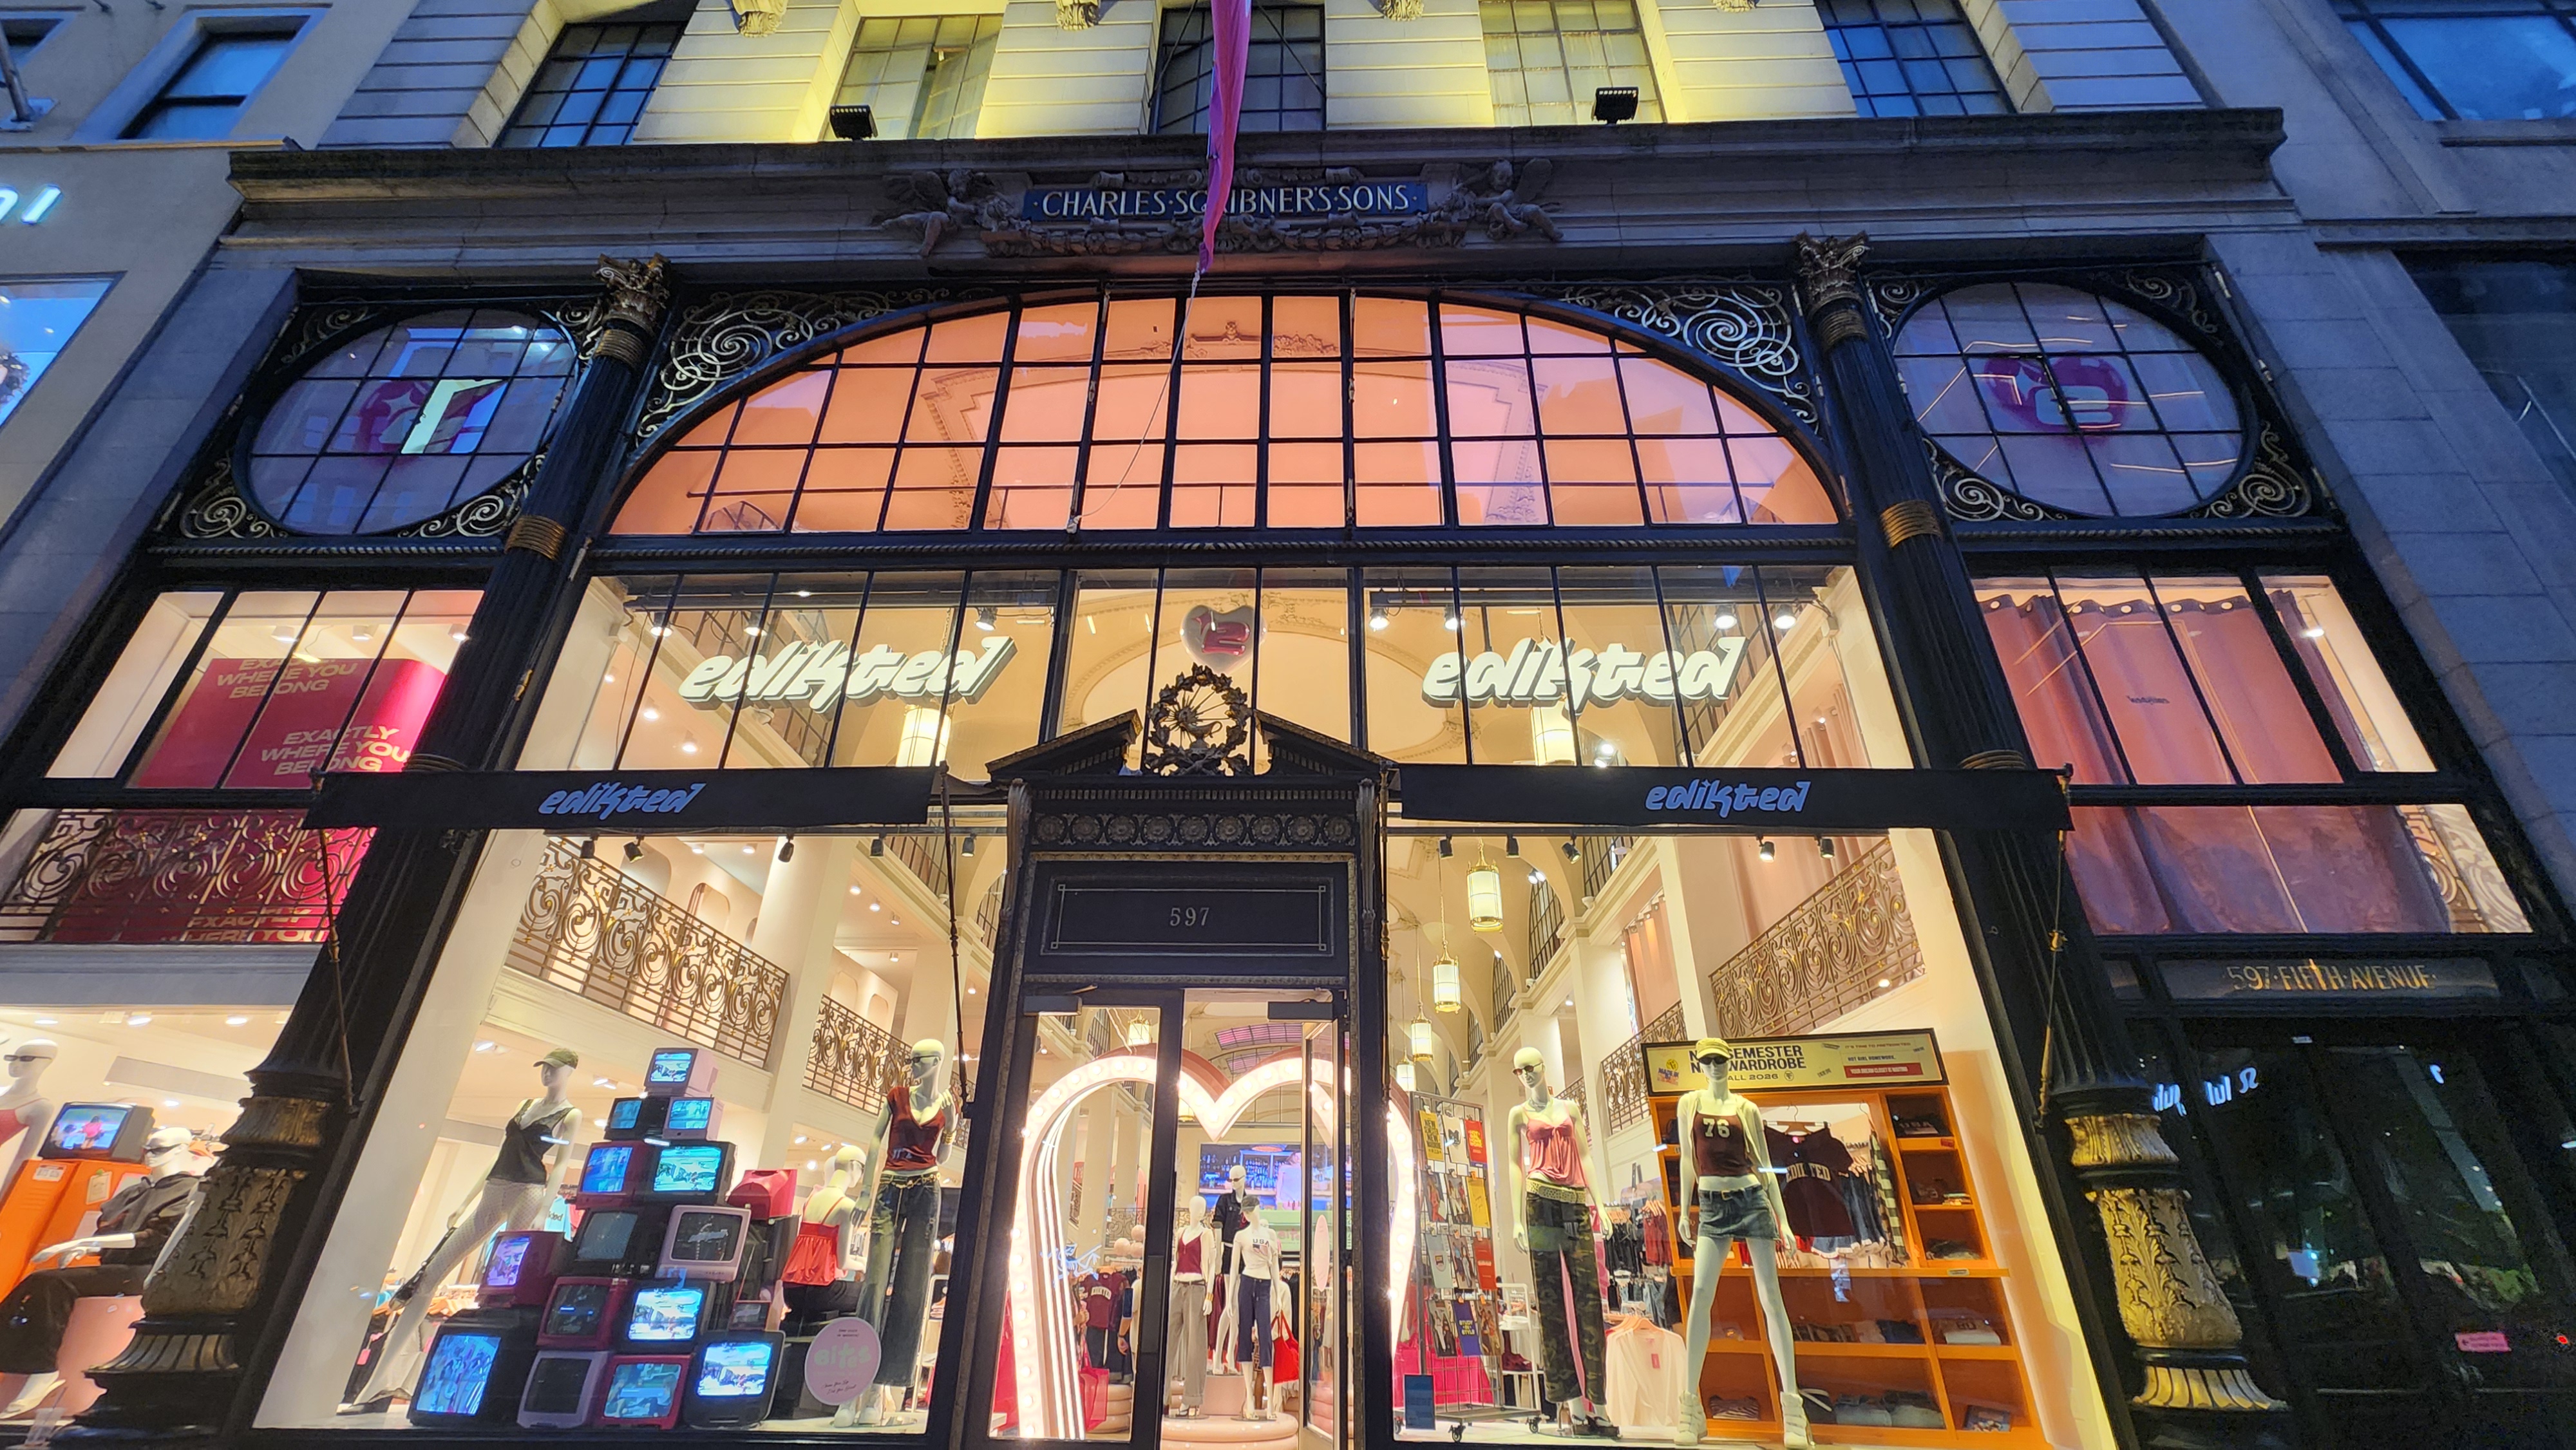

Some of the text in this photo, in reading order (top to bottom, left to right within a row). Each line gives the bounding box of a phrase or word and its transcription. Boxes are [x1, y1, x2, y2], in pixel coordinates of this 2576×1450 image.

[1043, 185, 1408, 216] CHARLES SCIBNER'S SONS
[308, 663, 357, 677] YOU
[678, 636, 1016, 715] edikted
[1422, 636, 1748, 716] edikted
[355, 741, 409, 762] YOU
[538, 782, 707, 820] edikted
[1645, 779, 1811, 818] edikted
[1170, 907, 1209, 927] 597
[2226, 964, 2430, 991] 597 FIFTH AVENUE
[1728, 1044, 1803, 1060] SEMESTER
[1728, 1057, 1807, 1072] WARDROBE
[1702, 1118, 1730, 1138] 76
[1786, 1162, 1832, 1183] EDITED
[1252, 1238, 1270, 1248] USA
